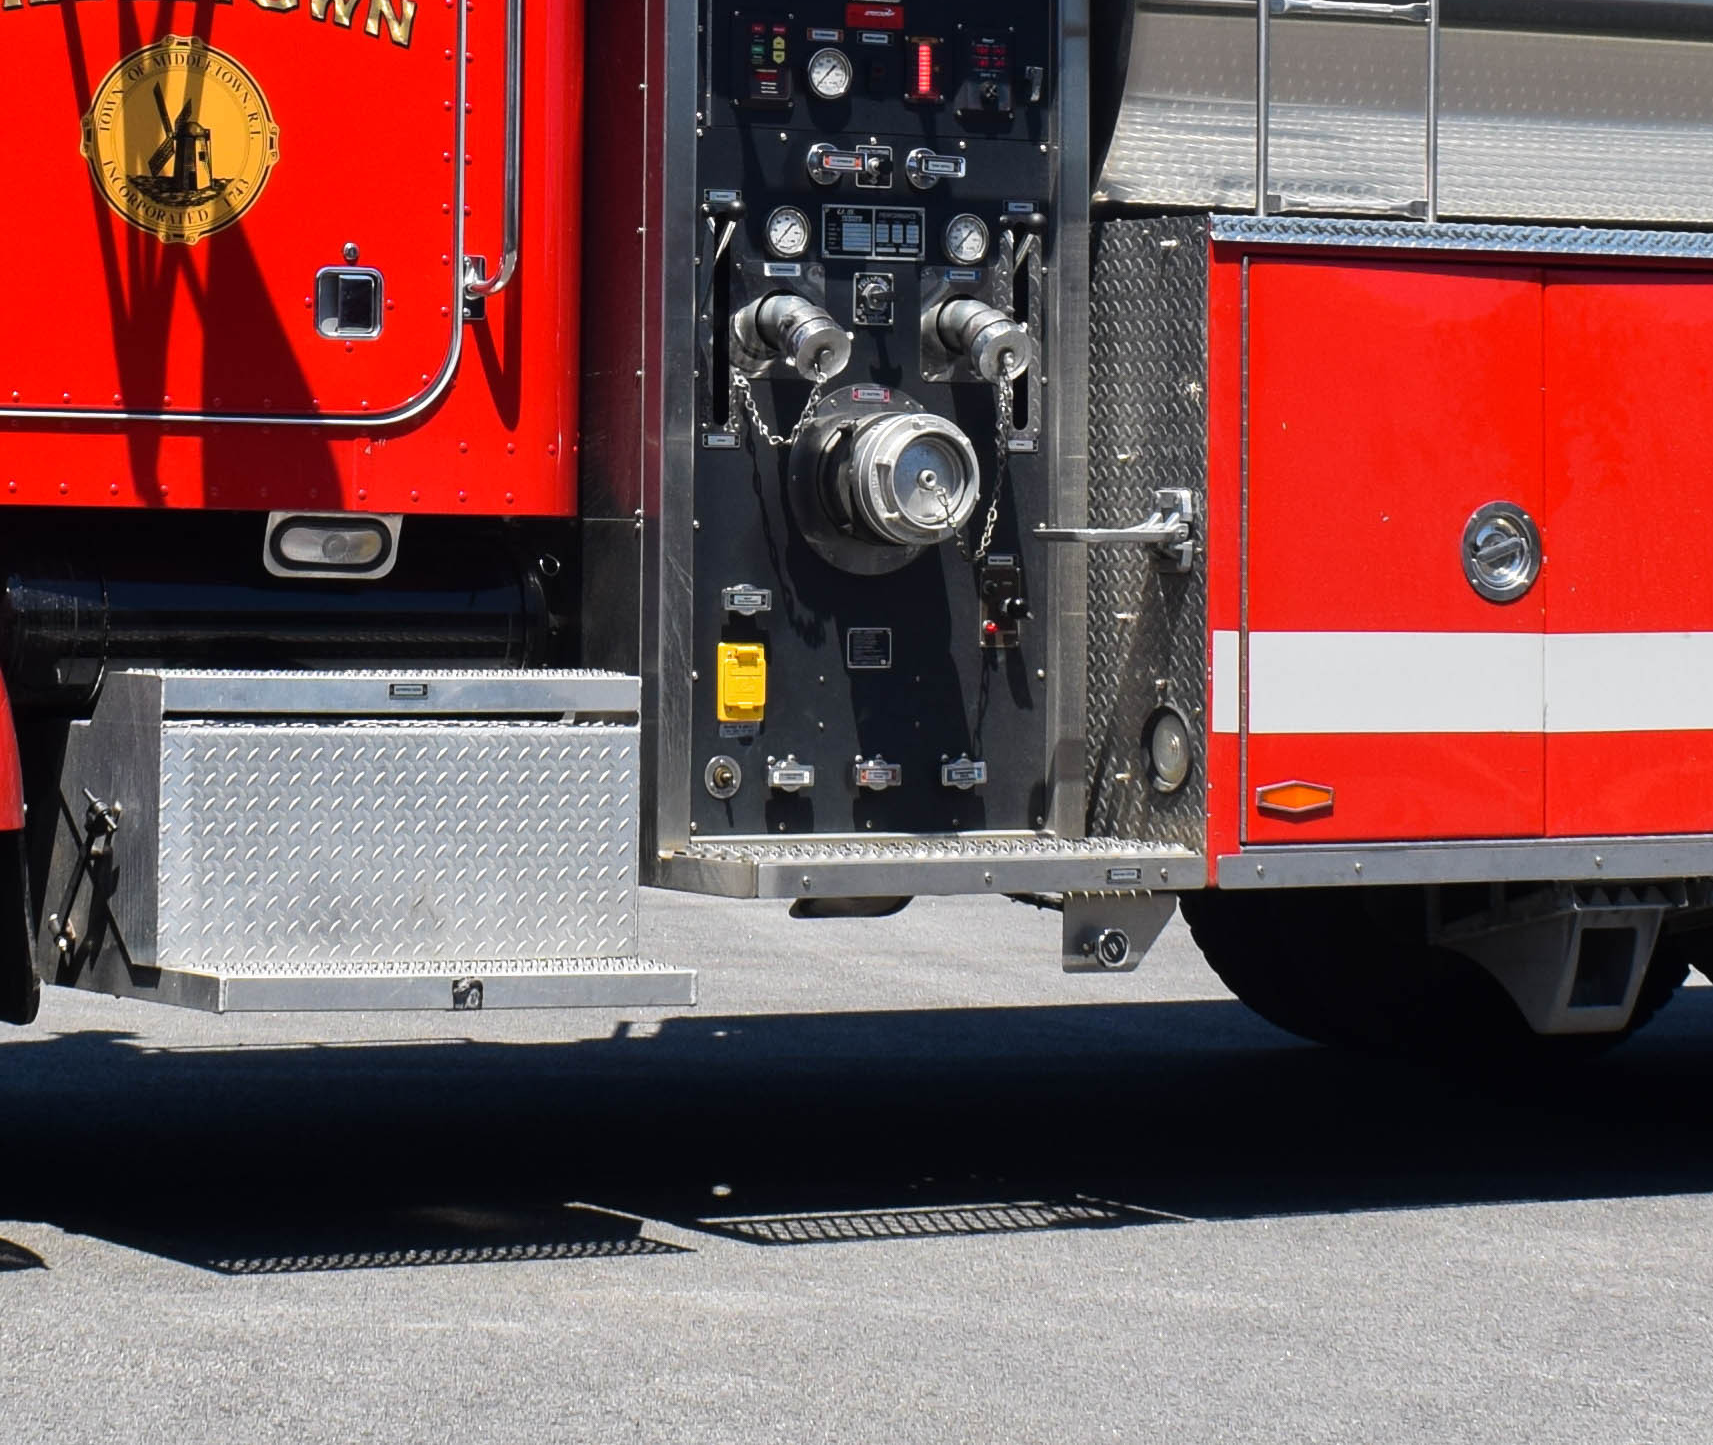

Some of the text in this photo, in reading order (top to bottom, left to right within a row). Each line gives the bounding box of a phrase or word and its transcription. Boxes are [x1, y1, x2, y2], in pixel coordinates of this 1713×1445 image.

[99, 88, 125, 132] TOWN
[127, 64, 147, 82] OF
[102, 159, 250, 226] INCORPORATED 1743
